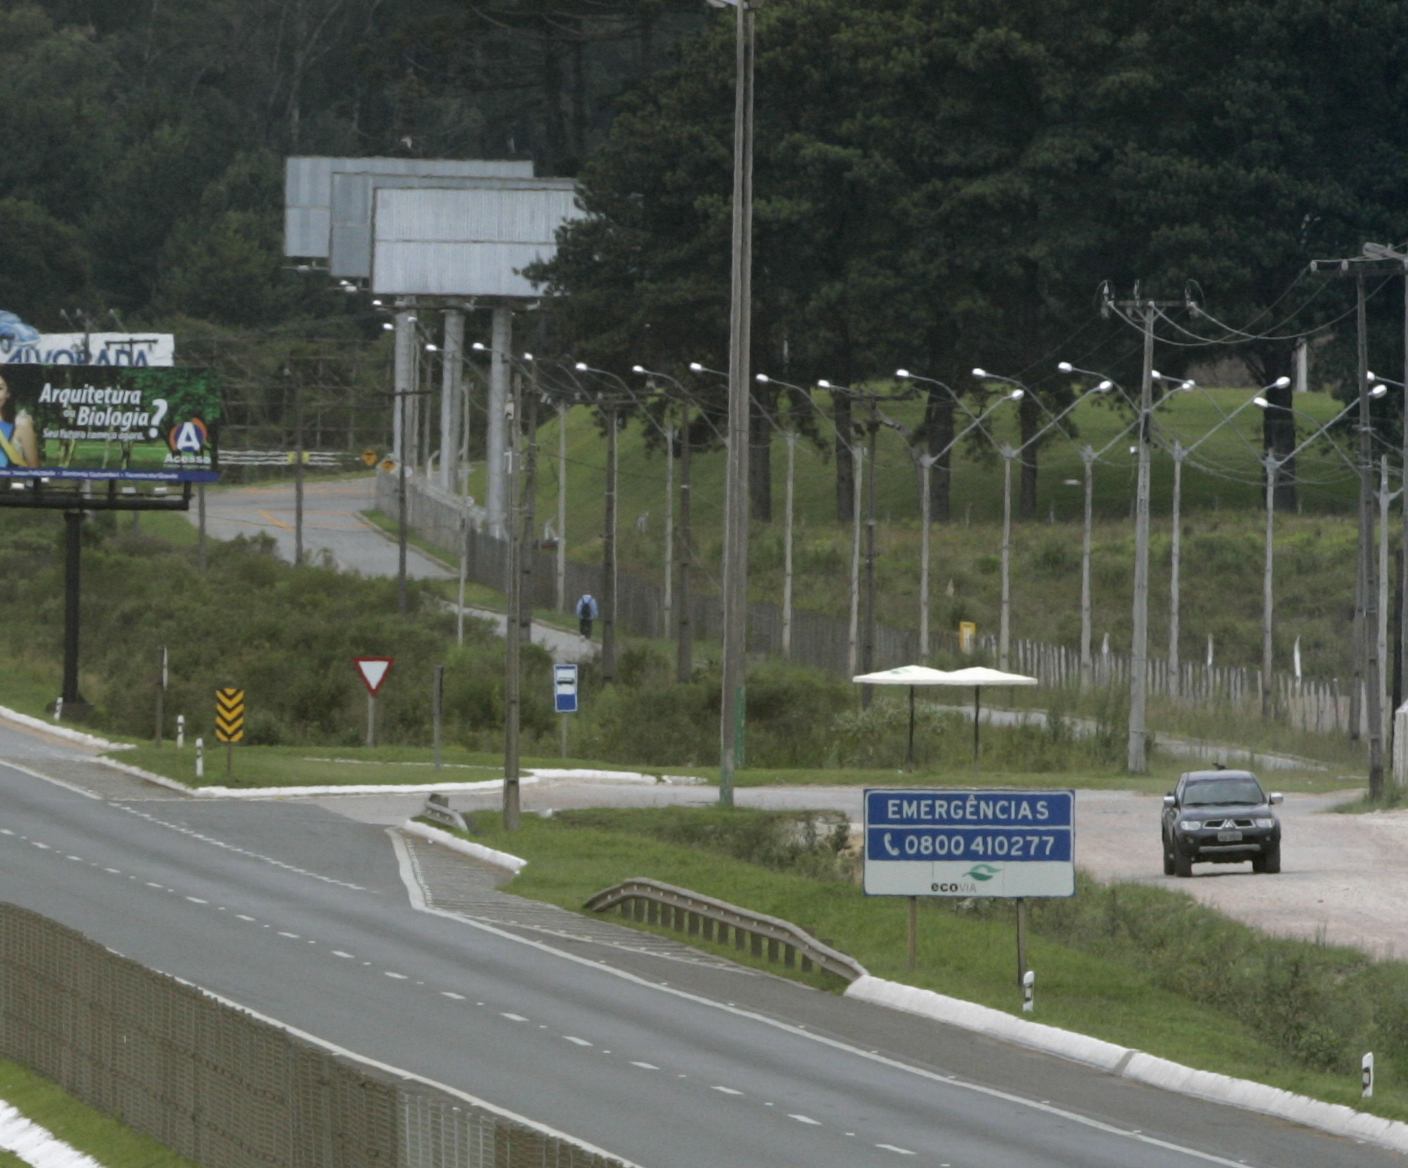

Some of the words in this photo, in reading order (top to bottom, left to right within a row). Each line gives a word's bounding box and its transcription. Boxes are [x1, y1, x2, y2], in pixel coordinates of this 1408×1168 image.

[39, 382, 142, 407] Arquitetura
[77, 406, 149, 431] Biologia
[887, 794, 1049, 820] EMERGÊNCIAS
[904, 834, 965, 855] 0800
[969, 835, 1055, 856] 410277
